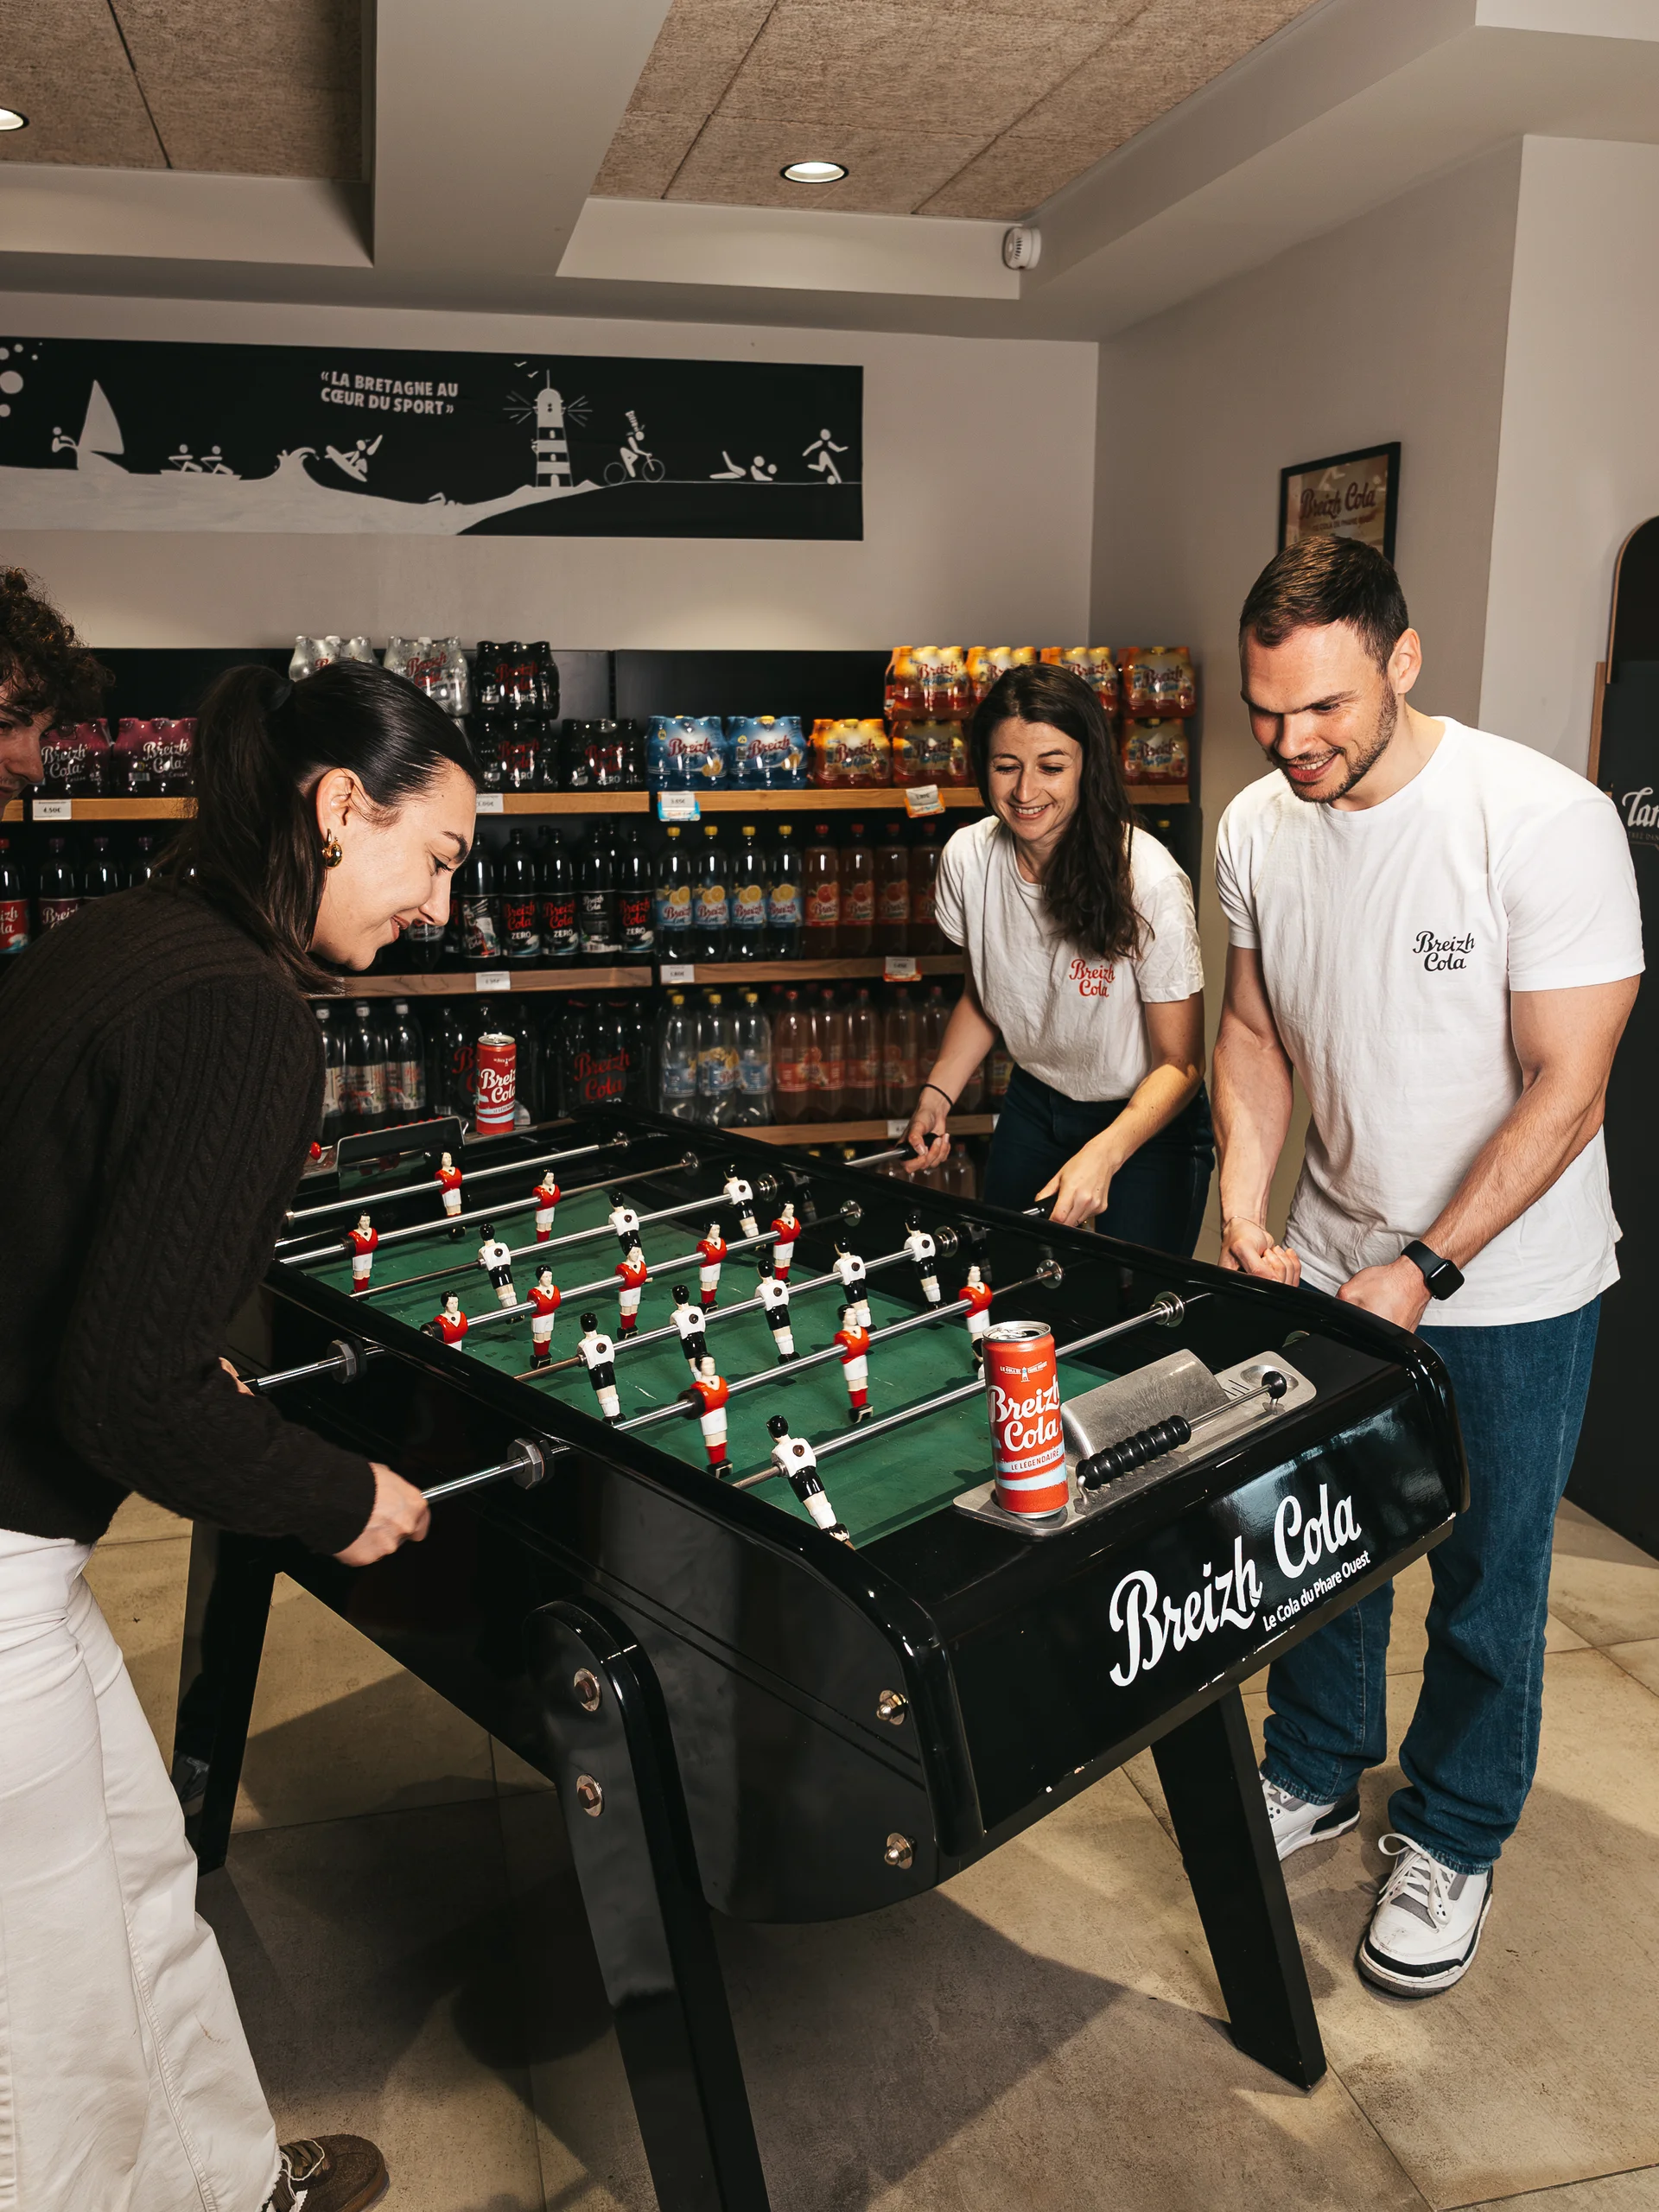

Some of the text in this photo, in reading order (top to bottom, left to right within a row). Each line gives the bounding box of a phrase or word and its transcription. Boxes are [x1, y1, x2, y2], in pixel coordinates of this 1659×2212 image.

[354, 374, 433, 396] BRETAGNE
[437, 383, 458, 397] AU
[321, 387, 364, 407] CŒUR
[368, 395, 391, 410] DU
[1300, 482, 1376, 519] Breizh Cola
[917, 661, 958, 679] Breizh
[509, 694, 532, 703] ZRO
[41, 743, 86, 765] Breizh
[143, 738, 189, 760] Breizh
[667, 737, 711, 757] Breizh
[747, 734, 791, 760] Breizh
[50, 761, 82, 779] Cola
[509, 771, 533, 781] ZRO
[0, 906, 18, 922] izh
[507, 916, 532, 931] Cola
[549, 915, 574, 929] Cola
[622, 912, 646, 927] Cola
[0, 923, 15, 935] la
[553, 929, 574, 938] ZERO
[626, 927, 645, 936] ZERO
[1412, 931, 1475, 954] Breizh
[1069, 958, 1116, 983] Breizh
[1424, 952, 1466, 971] Cola
[1079, 979, 1109, 998] Cola
[573, 1046, 631, 1082] Breizh
[584, 1077, 624, 1102] Cola
[987, 1374, 1060, 1424] Breizh
[1004, 1418, 1059, 1452] Cola
[1109, 1483, 1362, 1687] Breizh Cola
[1262, 1550, 1370, 1631] Le Cola du Phare Ouest
